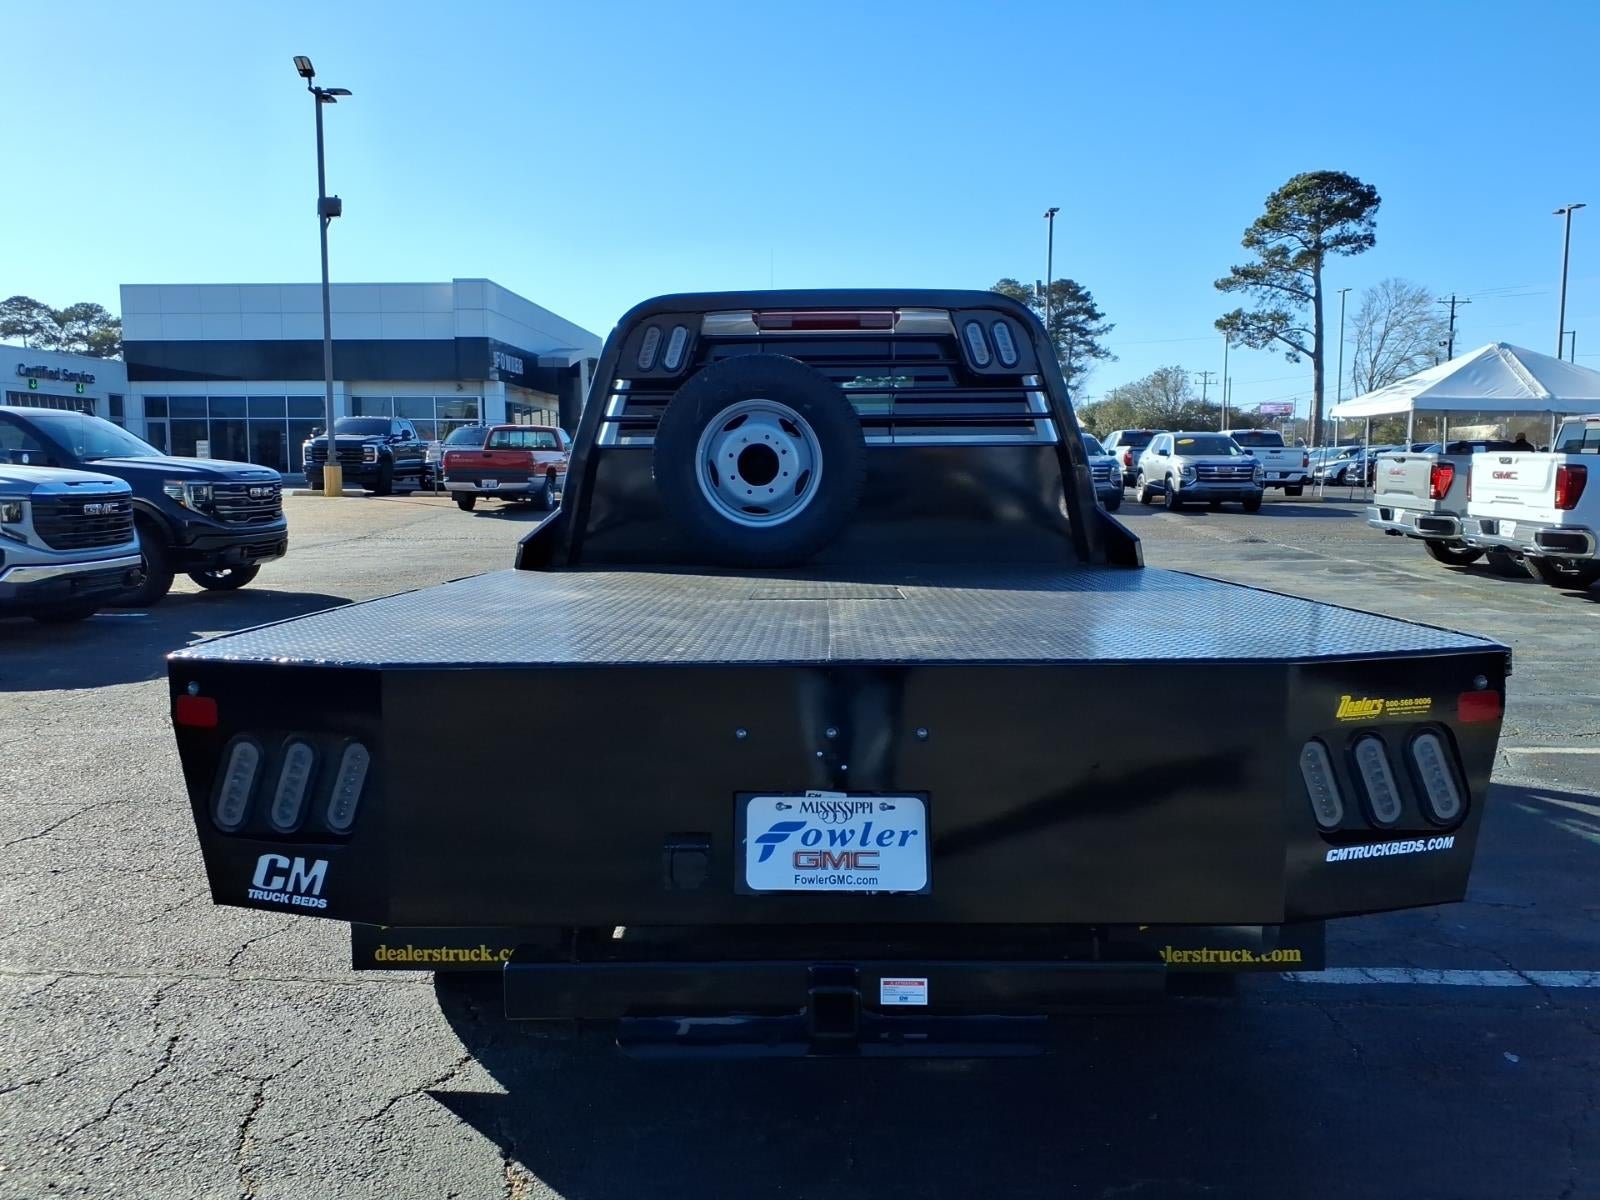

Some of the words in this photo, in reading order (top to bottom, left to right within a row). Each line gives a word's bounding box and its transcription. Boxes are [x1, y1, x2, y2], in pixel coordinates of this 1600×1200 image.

[18, 363, 60, 380] Certified
[62, 368, 96, 384] Service
[1389, 467, 1406, 476] GMC
[1492, 471, 1519, 480] GMC
[249, 487, 274, 498] GMC
[83, 502, 120, 515] GMC
[1336, 695, 1384, 718] Dealers
[799, 800, 873, 824] MISSISSIPPI
[754, 820, 919, 863] Fowler
[1326, 836, 1454, 863] CMTRUCKBEDS.COM
[792, 849, 881, 871] GMC
[252, 853, 329, 896] CM
[794, 874, 879, 887] FowlerGMC.com
[248, 888, 290, 905] TRUCK
[291, 894, 328, 909] BEDS
